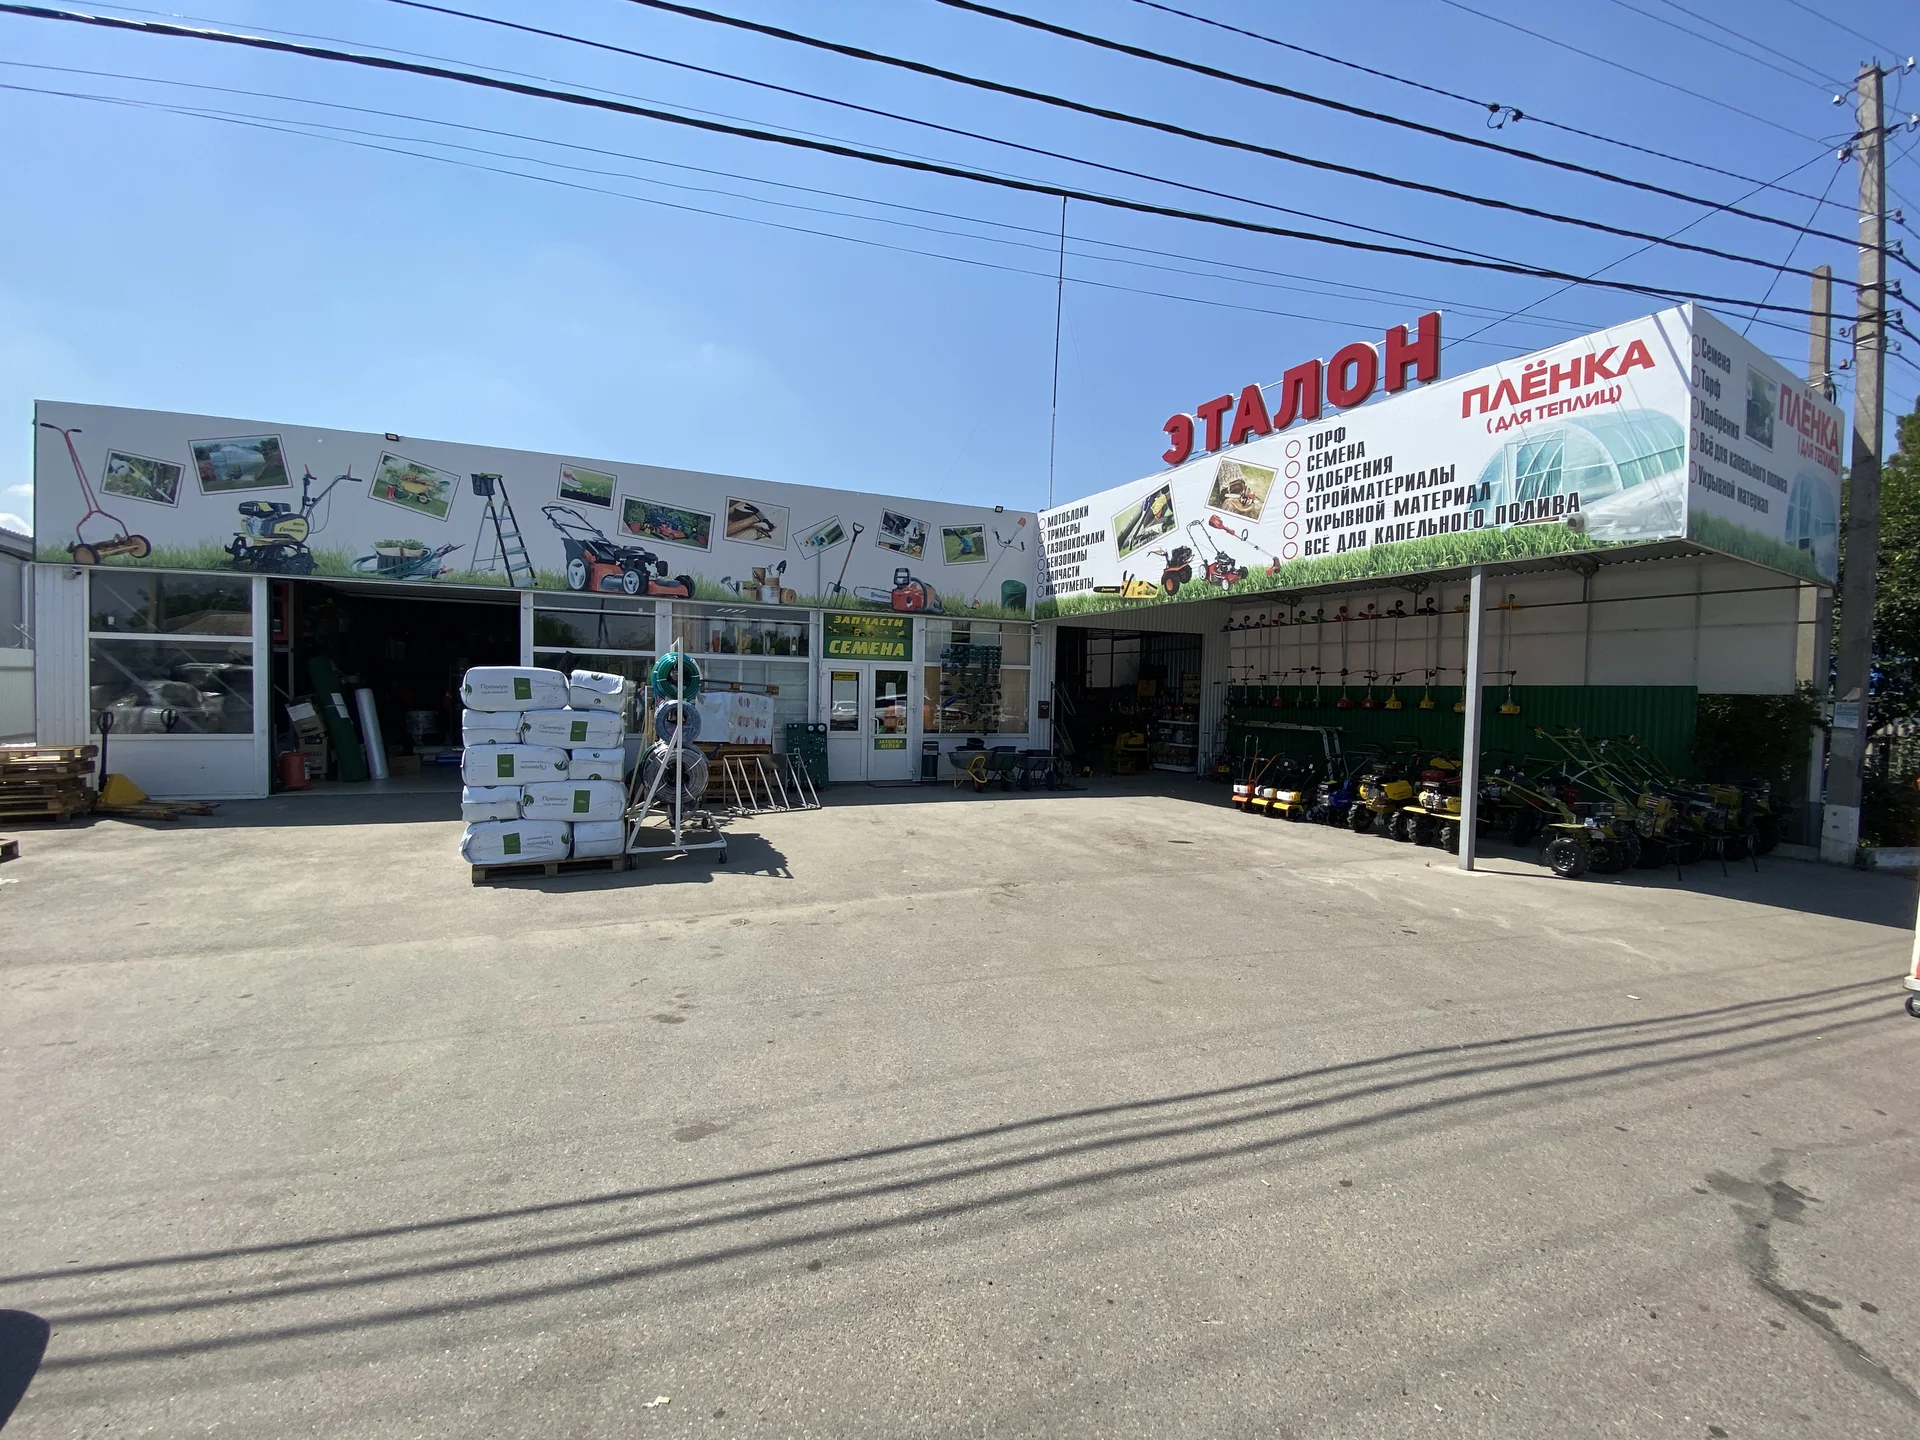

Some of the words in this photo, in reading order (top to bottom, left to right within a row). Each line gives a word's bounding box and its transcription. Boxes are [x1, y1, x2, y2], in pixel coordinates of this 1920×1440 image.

[1701, 337, 1731, 374] Семена
[1162, 310, 1442, 467] ЭТАЛОН
[1461, 338, 1656, 419] ПЛЁНКА
[1701, 368, 1721, 401] Торф
[1700, 400, 1740, 441] Удобрения
[1778, 382, 1839, 455] ПЛЁНКА
[1307, 427, 1346, 453] ТОРФ
[1307, 440, 1366, 473] СЕМЕНА
[1307, 455, 1393, 493] УДОБРЕНИЯ
[1700, 432, 1714, 458] Всё
[1714, 444, 1728, 464] для
[1729, 449, 1767, 486] капельного
[1766, 470, 1788, 494] полива
[1306, 464, 1456, 514] СТРОЙМАТЕРИАЛЫ
[1698, 464, 1735, 500] Укрывной
[1737, 485, 1769, 515] материал
[1047, 505, 1089, 528] МОТОБЛОКИ
[1304, 535, 1330, 557] ВСЁ
[1337, 529, 1367, 554] ДЛЯ
[1374, 507, 1484, 545] КАПЕЛЬНОГО
[1494, 491, 1580, 525] ПОЛИВА
[1306, 498, 1385, 535] УКРЫВНОЙ
[1394, 481, 1491, 518] МАТЕРИАЛ
[1046, 530, 1105, 555] ГАЗОНОКОСИЛКИ
[1047, 522, 1081, 541] ТРИМЕРЫ
[1046, 549, 1088, 569] БЕНЗОПИЛЫ
[1046, 565, 1080, 582] ЗАПЧАСТИ
[1045, 577, 1094, 596] ИНСТРУМЕНТЫ
[833, 615, 904, 627] ЗАПЧАСТИ
[828, 639, 905, 656] СЕМЕНА
